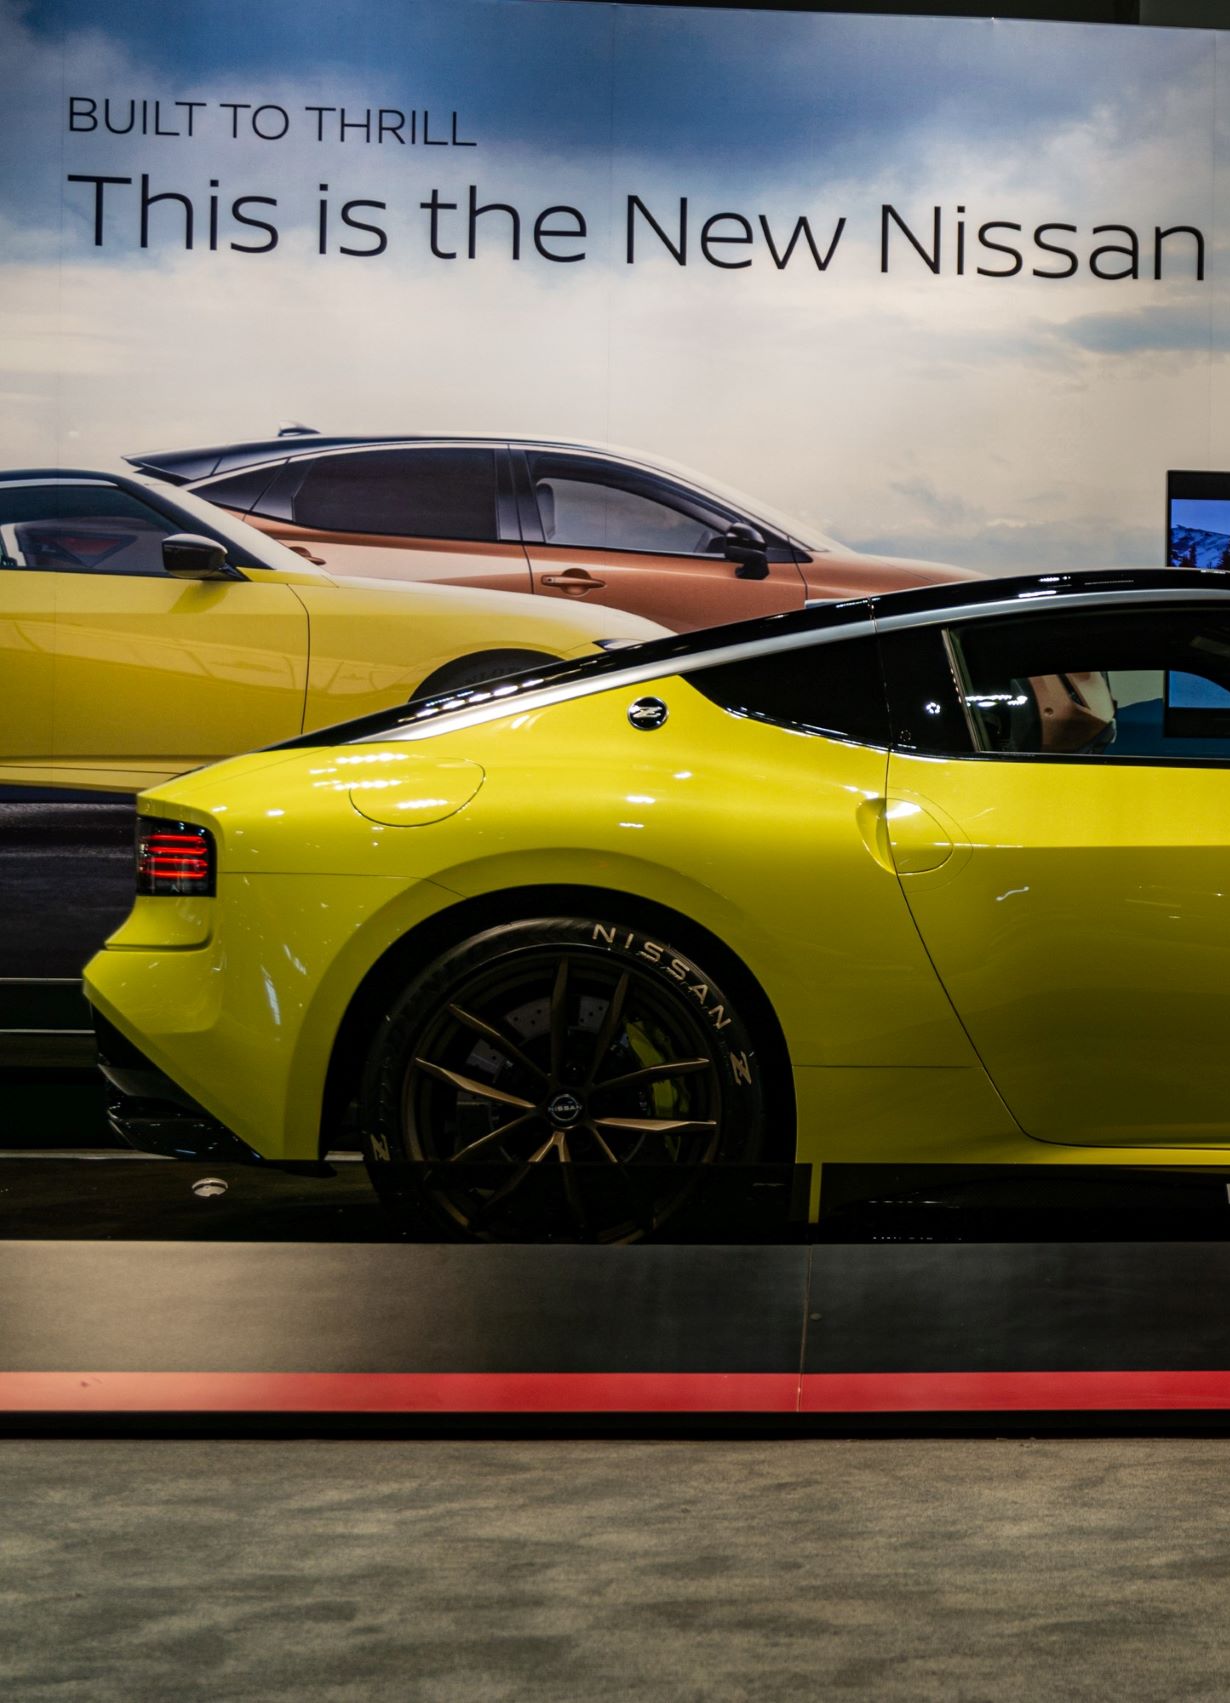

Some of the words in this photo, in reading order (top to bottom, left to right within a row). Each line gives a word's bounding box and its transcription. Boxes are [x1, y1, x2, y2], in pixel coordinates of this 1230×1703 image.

[69, 96, 207, 137] BUILT
[219, 103, 290, 141] TO
[304, 106, 478, 147] THRILL
[67, 173, 279, 254] This
[319, 183, 388, 257] is
[419, 184, 587, 263] the
[626, 194, 847, 272] New
[880, 204, 1205, 281] Nissan
[592, 923, 733, 1031] NISSAN
